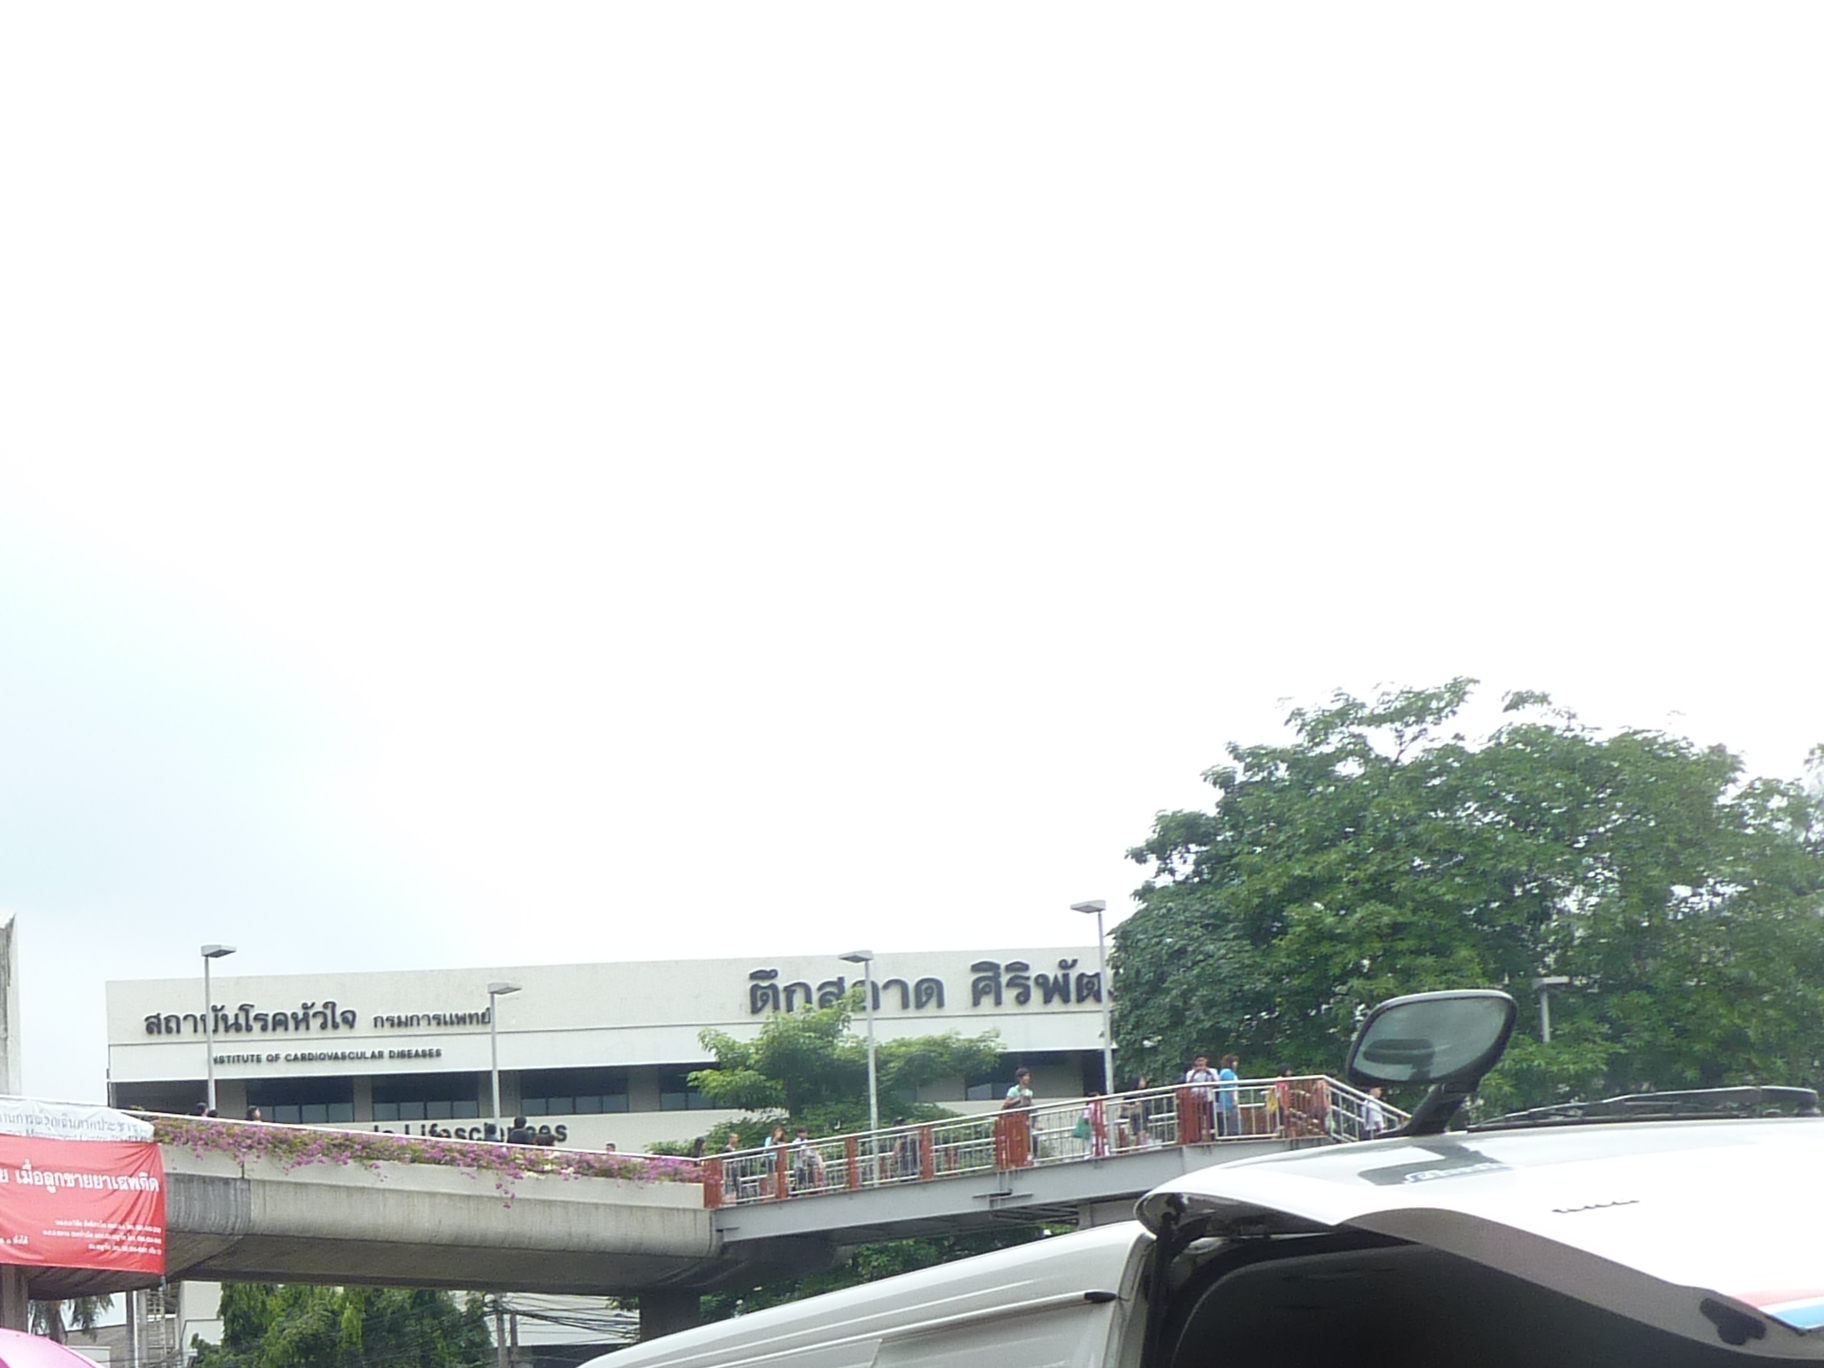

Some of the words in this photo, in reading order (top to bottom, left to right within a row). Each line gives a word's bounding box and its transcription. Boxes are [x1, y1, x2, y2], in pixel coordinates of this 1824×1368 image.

[266, 1052, 281, 1063] OF
[284, 1049, 385, 1062] CARDIOVASCULAR
[388, 1048, 443, 1060] DISEASES
